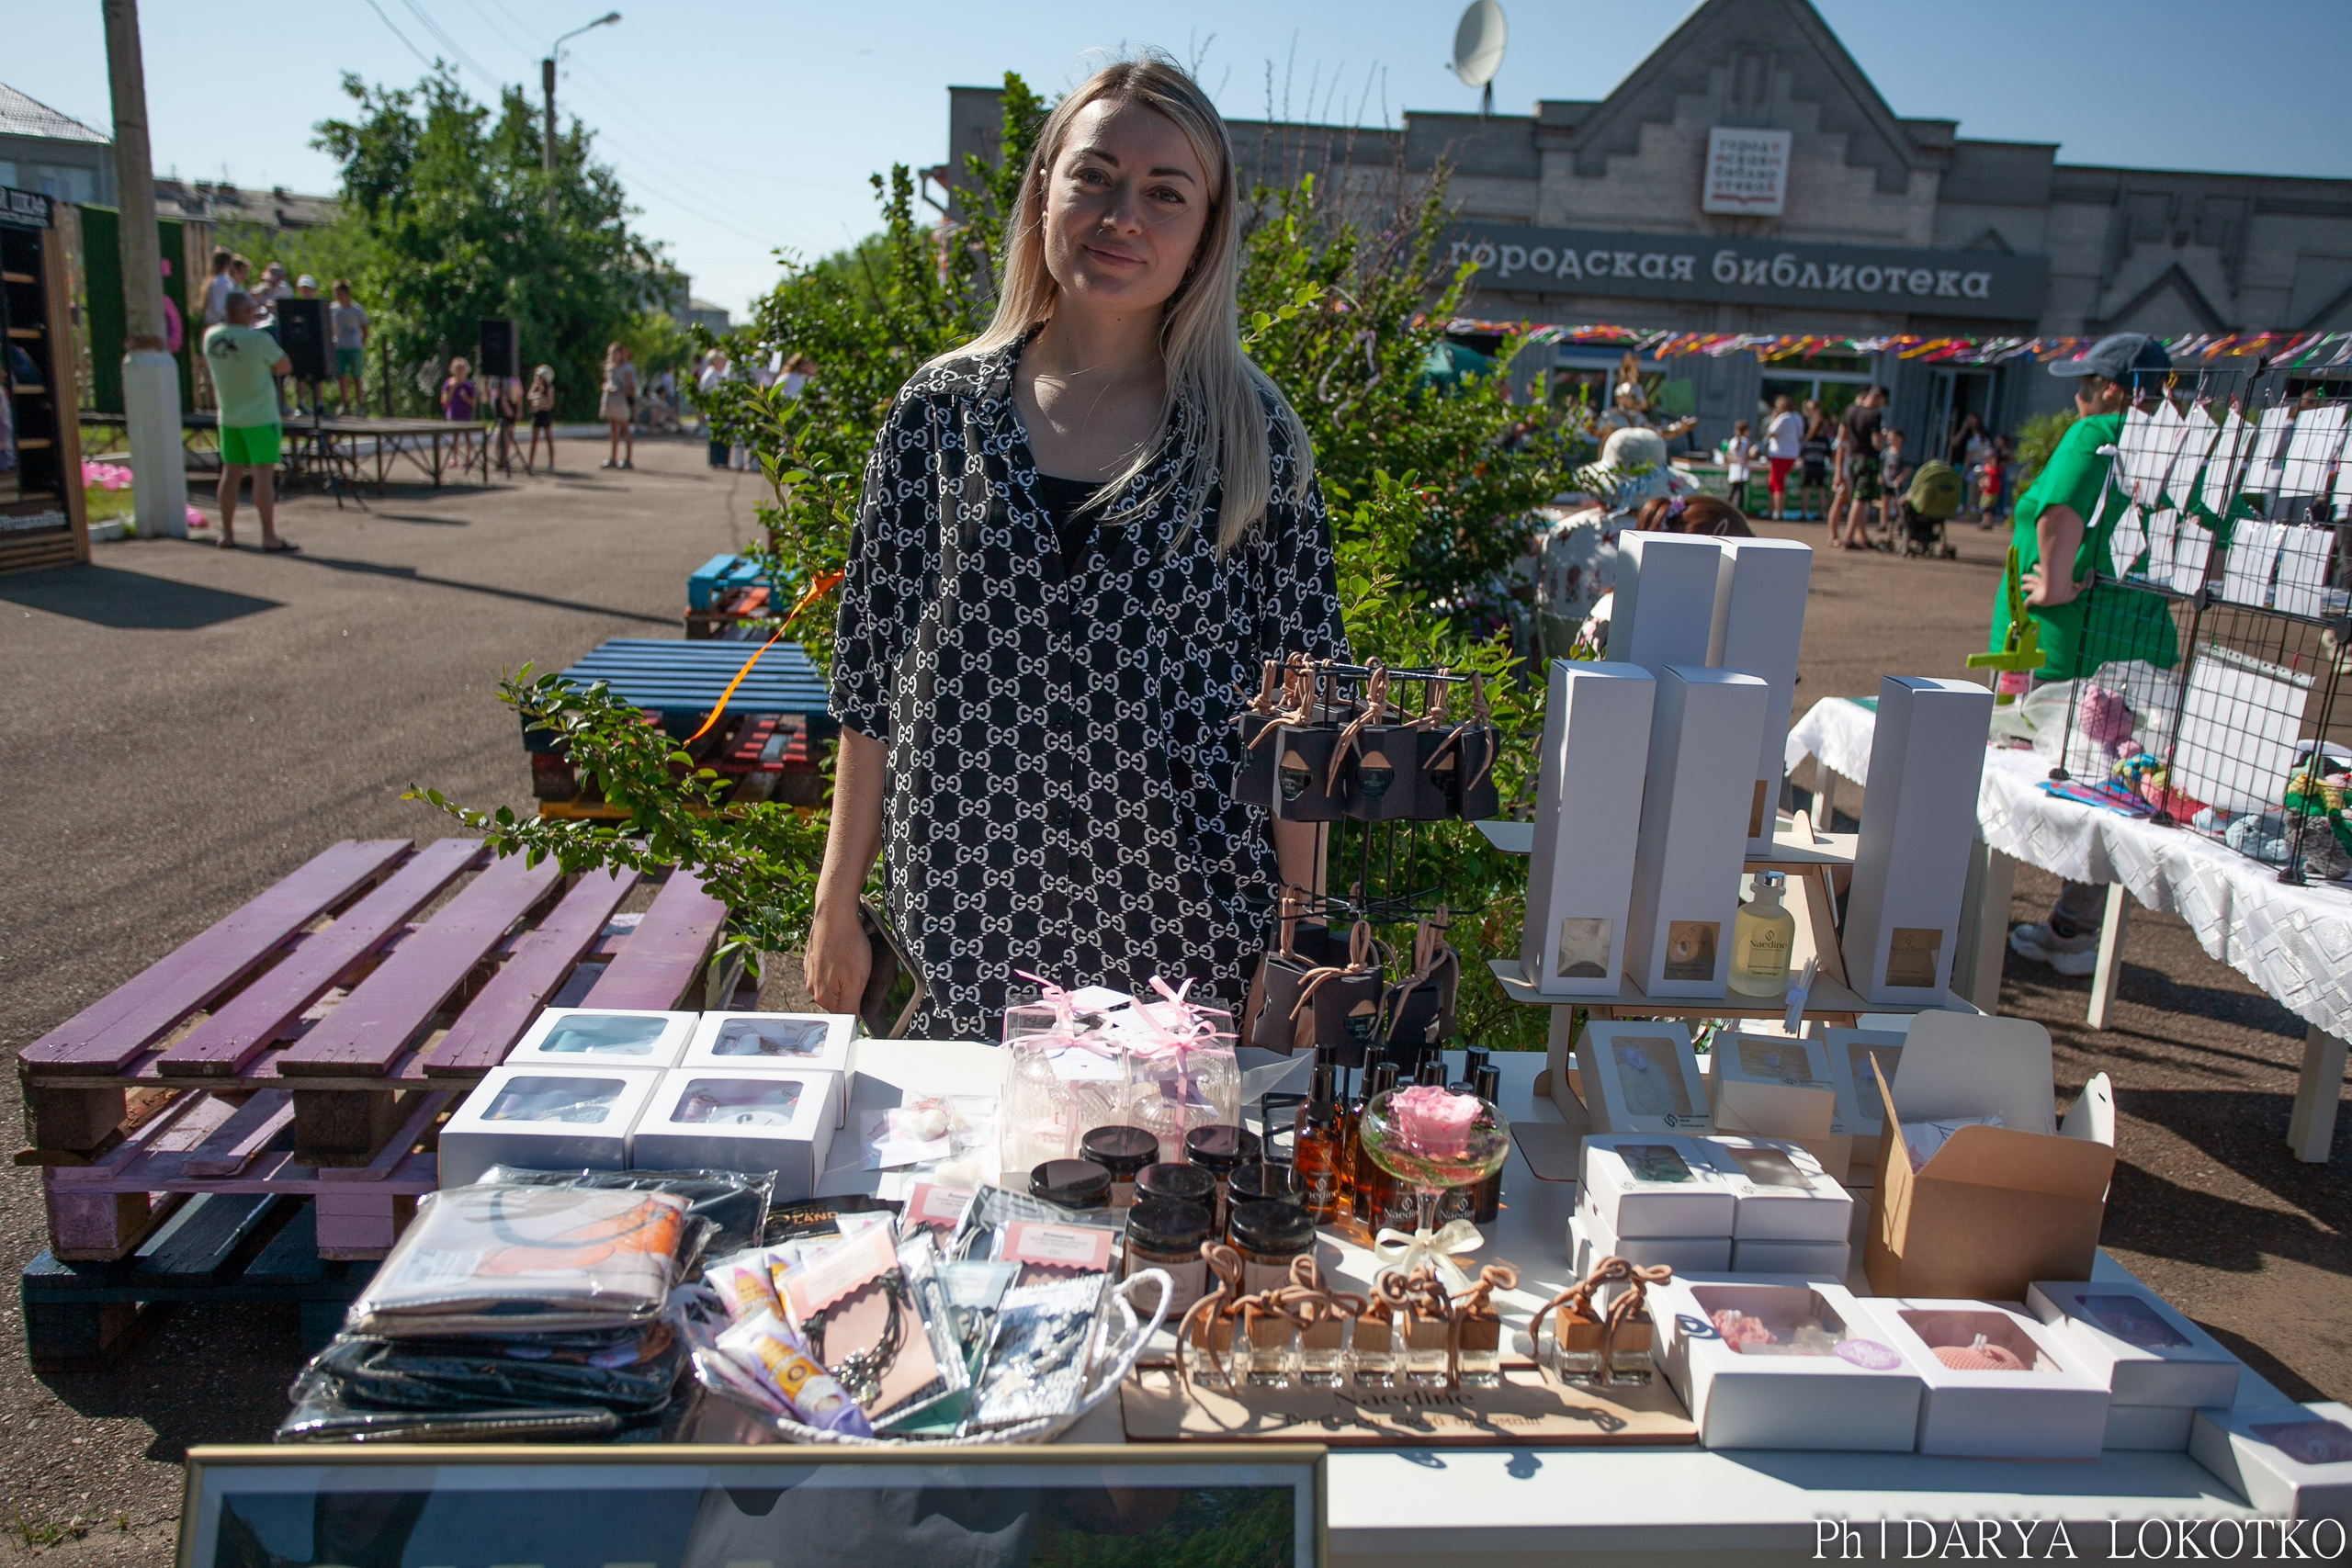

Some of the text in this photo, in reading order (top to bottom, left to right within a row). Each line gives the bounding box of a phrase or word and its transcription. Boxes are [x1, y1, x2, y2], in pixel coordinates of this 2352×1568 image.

[1451, 241, 1993, 299] городская библиотека
[1749, 939, 1788, 949] Naedine
[1384, 1207, 1419, 1220] Naedin
[1333, 1390, 1476, 1407] Naedine
